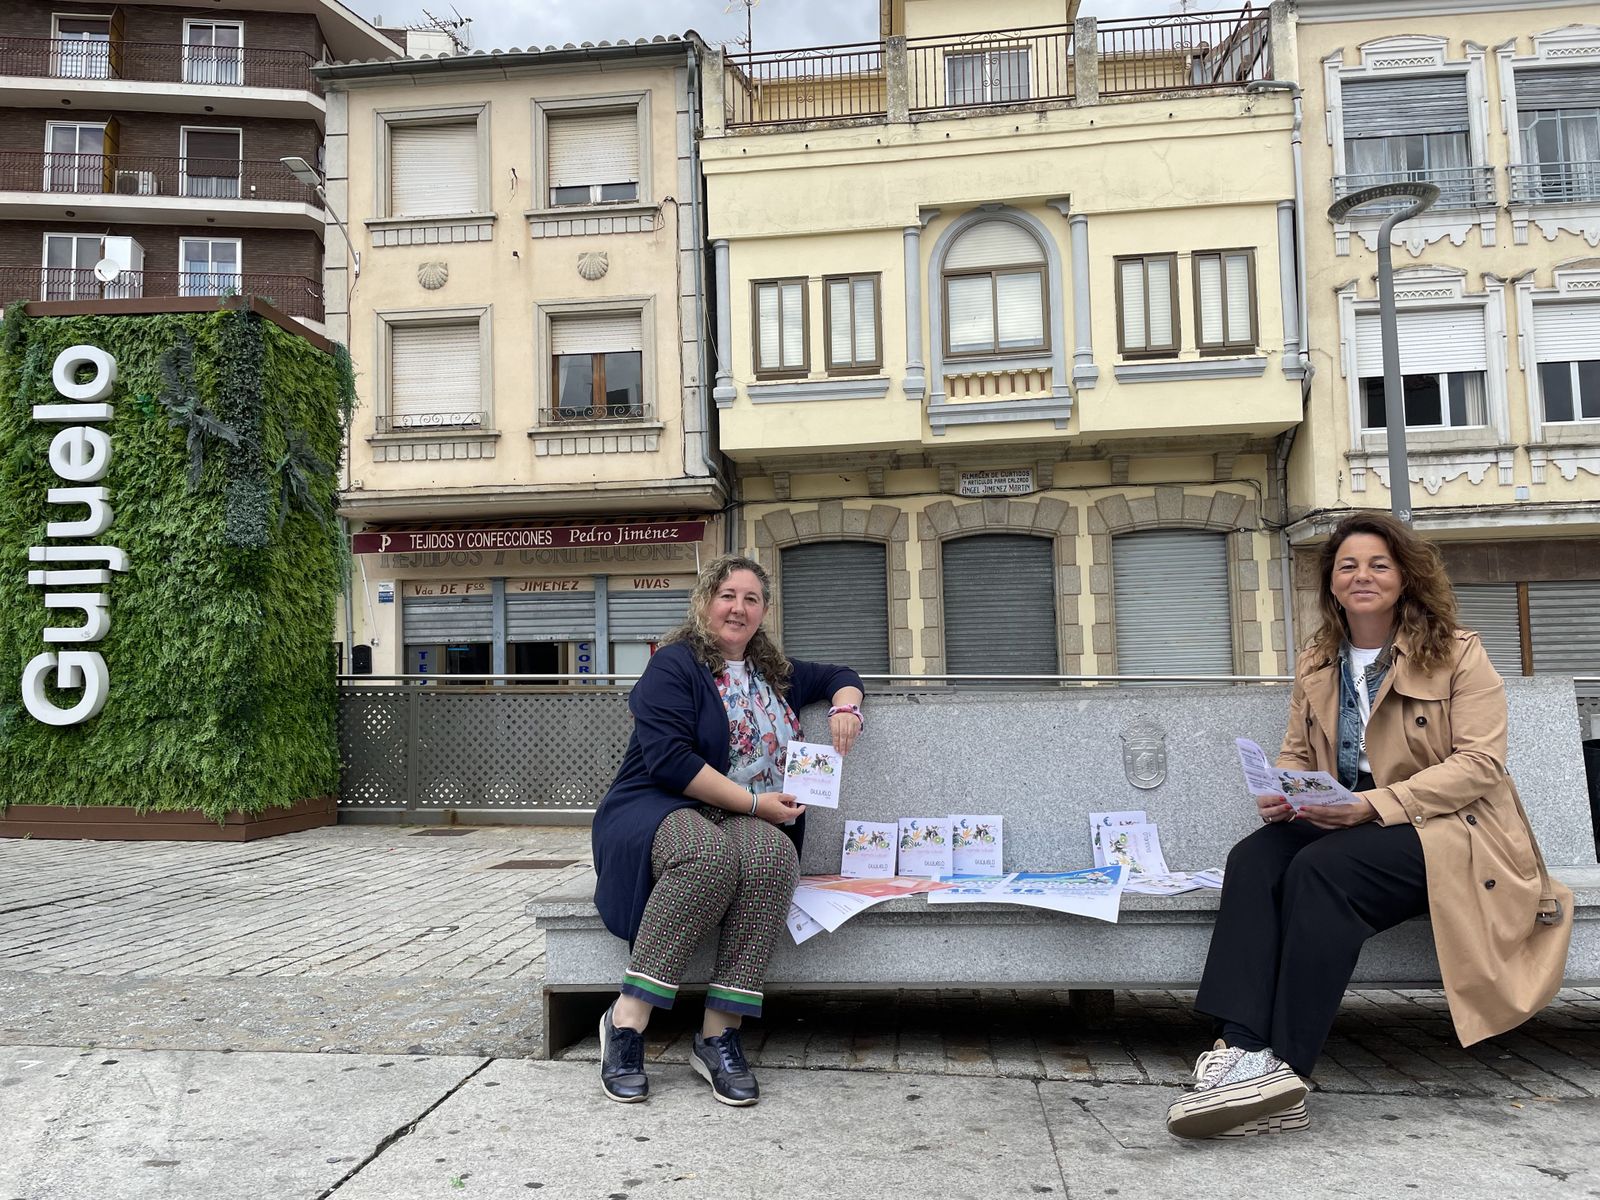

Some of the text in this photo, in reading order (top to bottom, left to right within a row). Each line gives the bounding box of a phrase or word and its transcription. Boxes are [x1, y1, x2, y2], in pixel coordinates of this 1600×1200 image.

[1000, 470, 1030, 478] CURTIDOS
[22, 344, 129, 726] Guijuelo
[409, 525, 679, 549] TEJIDOS Y CONFECCIONES Pedro Jiménez
[440, 583, 458, 595] DE
[519, 580, 580, 592] JIMENEZ
[633, 578, 670, 590] VIVAS
